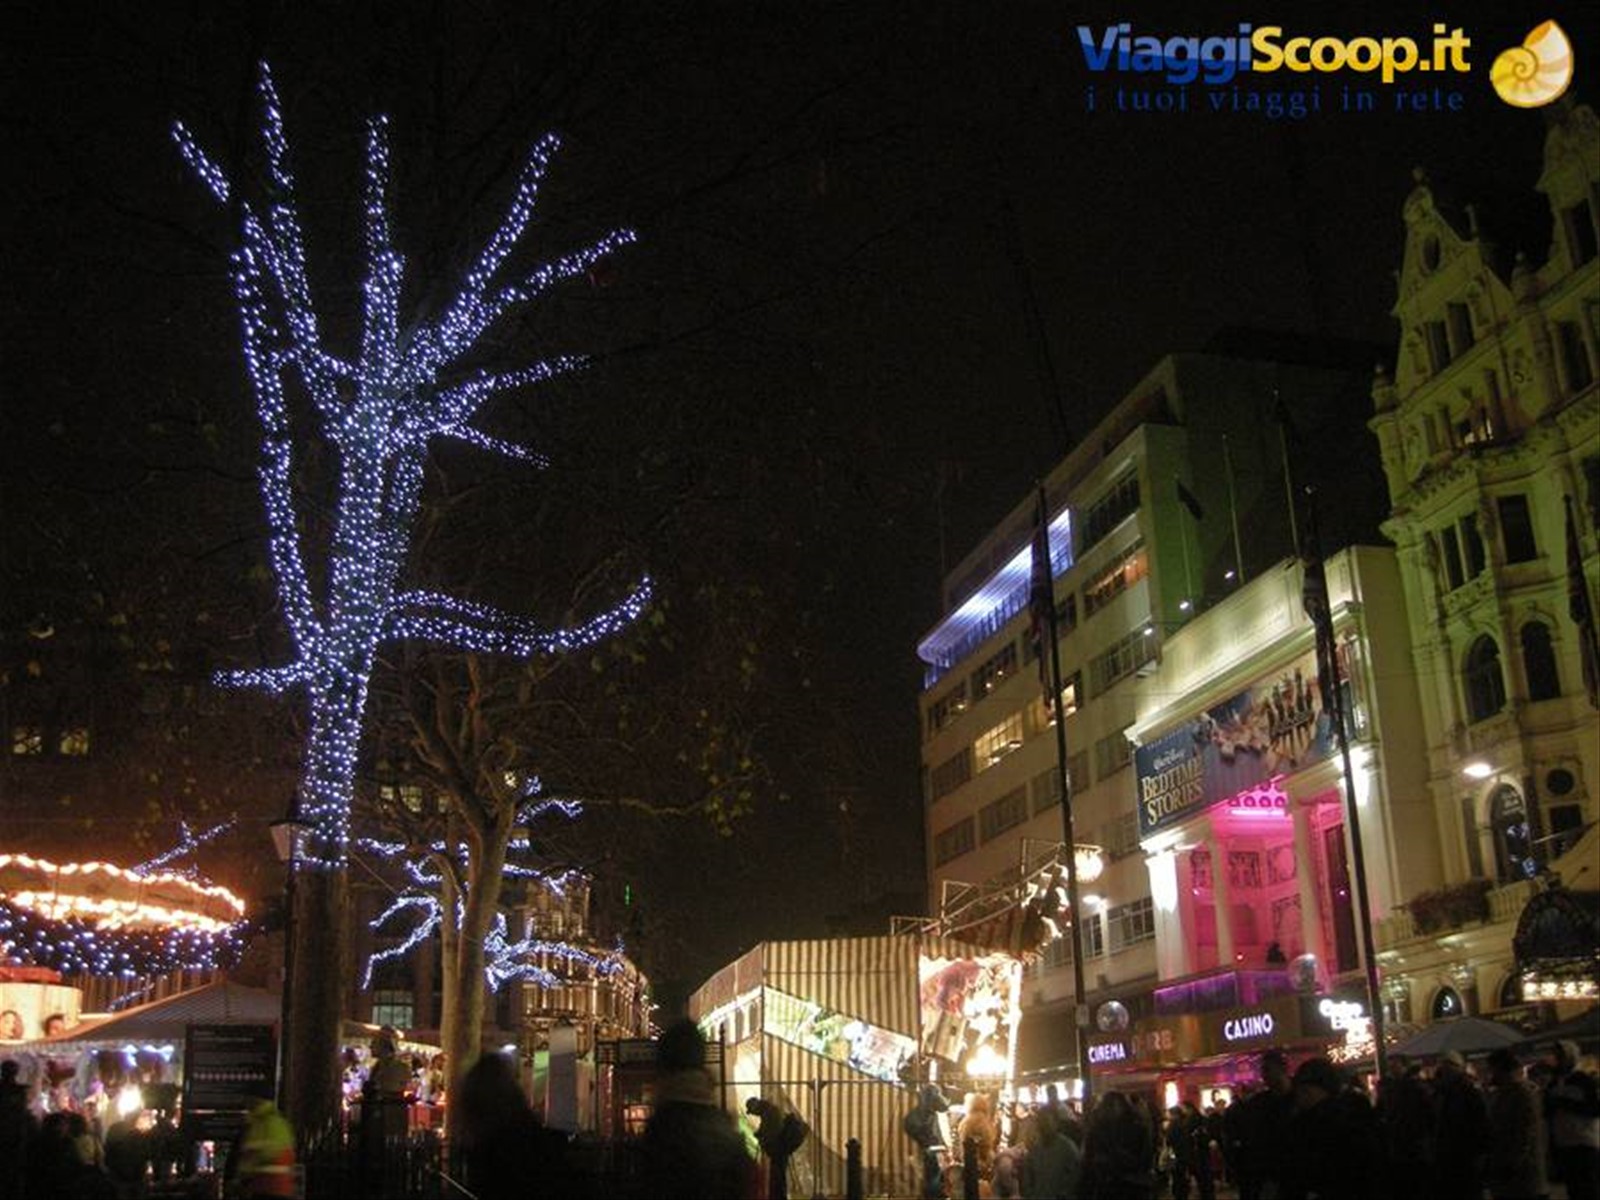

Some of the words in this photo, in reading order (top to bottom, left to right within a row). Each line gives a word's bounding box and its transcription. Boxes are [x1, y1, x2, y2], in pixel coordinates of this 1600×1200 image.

[1142, 755, 1205, 802] BEDTIME
[1147, 777, 1204, 825] STORIES
[1224, 1013, 1273, 1040] CASINO
[1088, 1042, 1126, 1063] CINEMA
